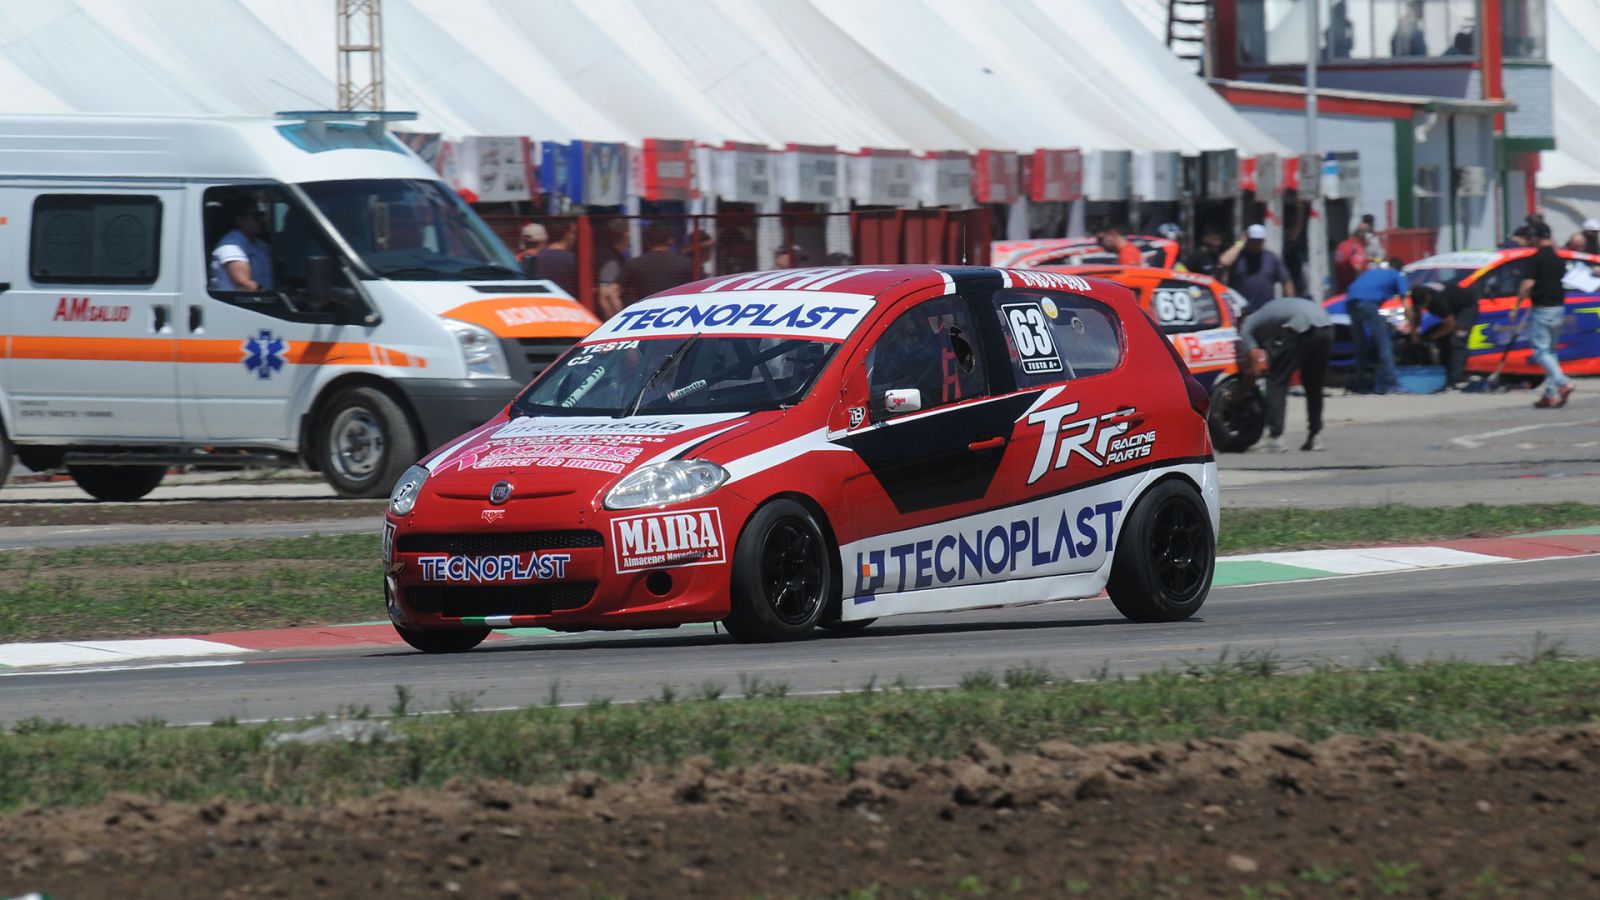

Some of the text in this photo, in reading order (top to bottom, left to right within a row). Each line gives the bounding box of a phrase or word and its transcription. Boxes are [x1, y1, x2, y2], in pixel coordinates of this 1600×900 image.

[611, 303, 859, 332] TECNOPLAST
[1156, 291, 1193, 322] 69
[1009, 308, 1053, 356] 63
[581, 340, 640, 355] TESTA
[567, 355, 594, 367] C2
[1027, 361, 1047, 370] TESTA
[1110, 430, 1157, 452] RACING
[563, 458, 625, 473] mama
[1106, 444, 1152, 466] PARTS
[619, 512, 719, 556] MAIRA
[890, 500, 1123, 593] TECNOPLAST
[419, 553, 570, 582] TECNOPLAST
[623, 554, 666, 568] Almacenes
[667, 550, 705, 562] Mayoristas
